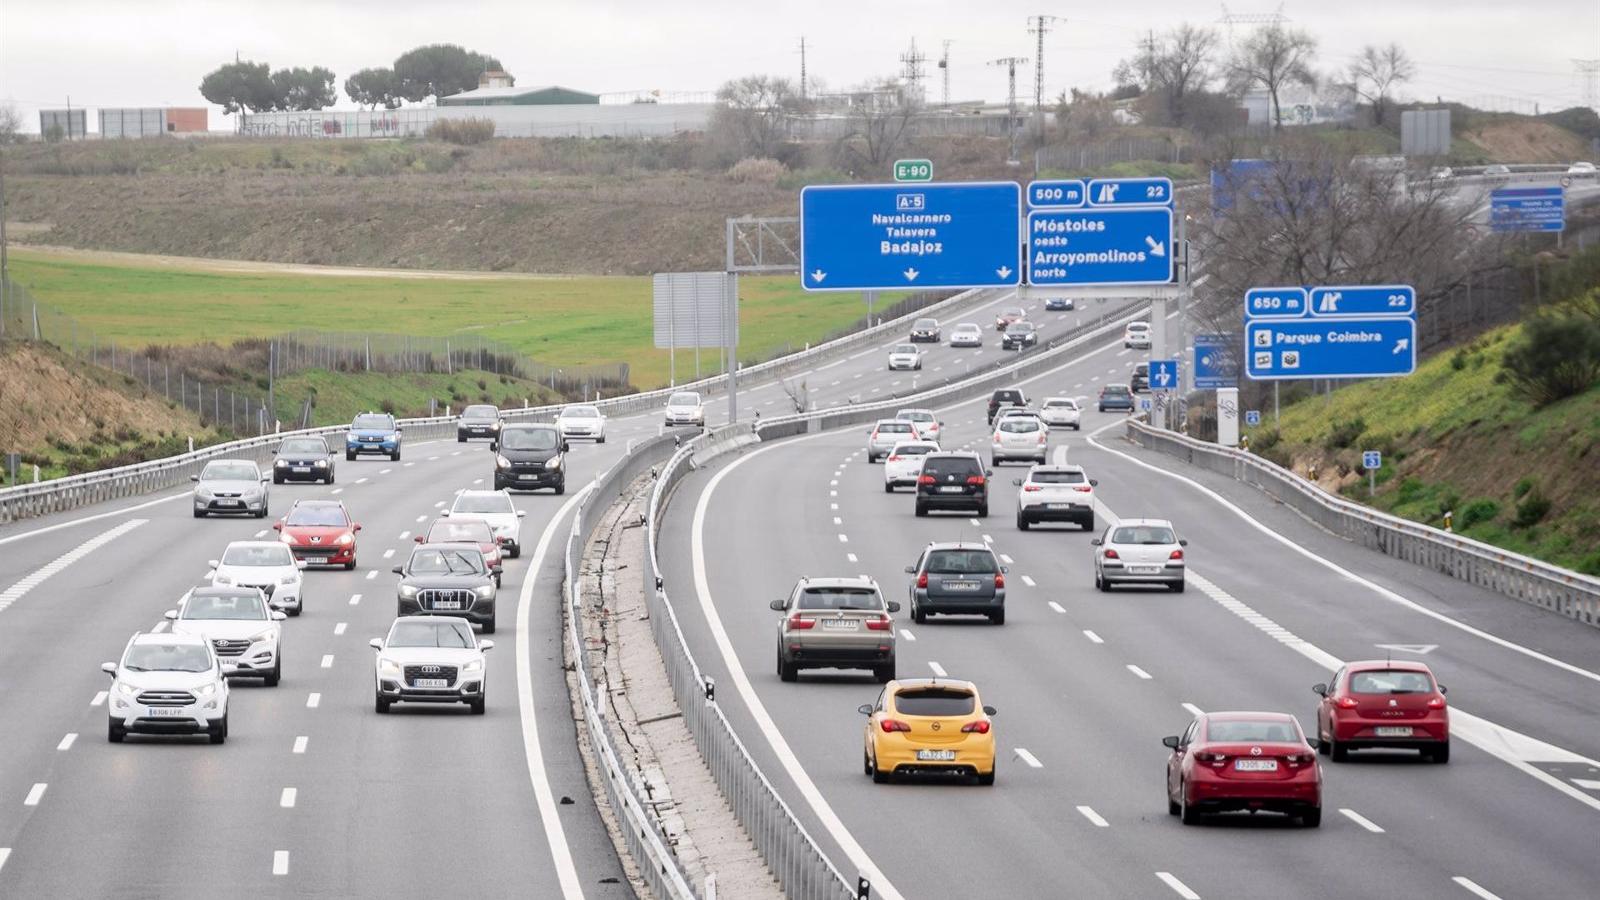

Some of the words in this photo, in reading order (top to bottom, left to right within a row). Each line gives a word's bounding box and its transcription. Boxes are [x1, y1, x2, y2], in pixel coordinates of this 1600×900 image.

[1036, 188, 1063, 200] 500
[1067, 189, 1078, 200] m
[1146, 186, 1164, 198] 22
[872, 213, 952, 225] Navalcarnero
[1034, 218, 1106, 233] Móstoles
[886, 226, 937, 238] Talavera
[1034, 235, 1069, 247] oeste
[880, 240, 943, 256] Badajoz
[1034, 249, 1147, 266] Arroyomolinos
[1034, 267, 1067, 278] norte
[1253, 297, 1281, 309] 650
[1286, 298, 1300, 308] m
[1388, 294, 1407, 307] 22
[1276, 332, 1322, 346] Parque
[1327, 331, 1383, 343] Coimbra
